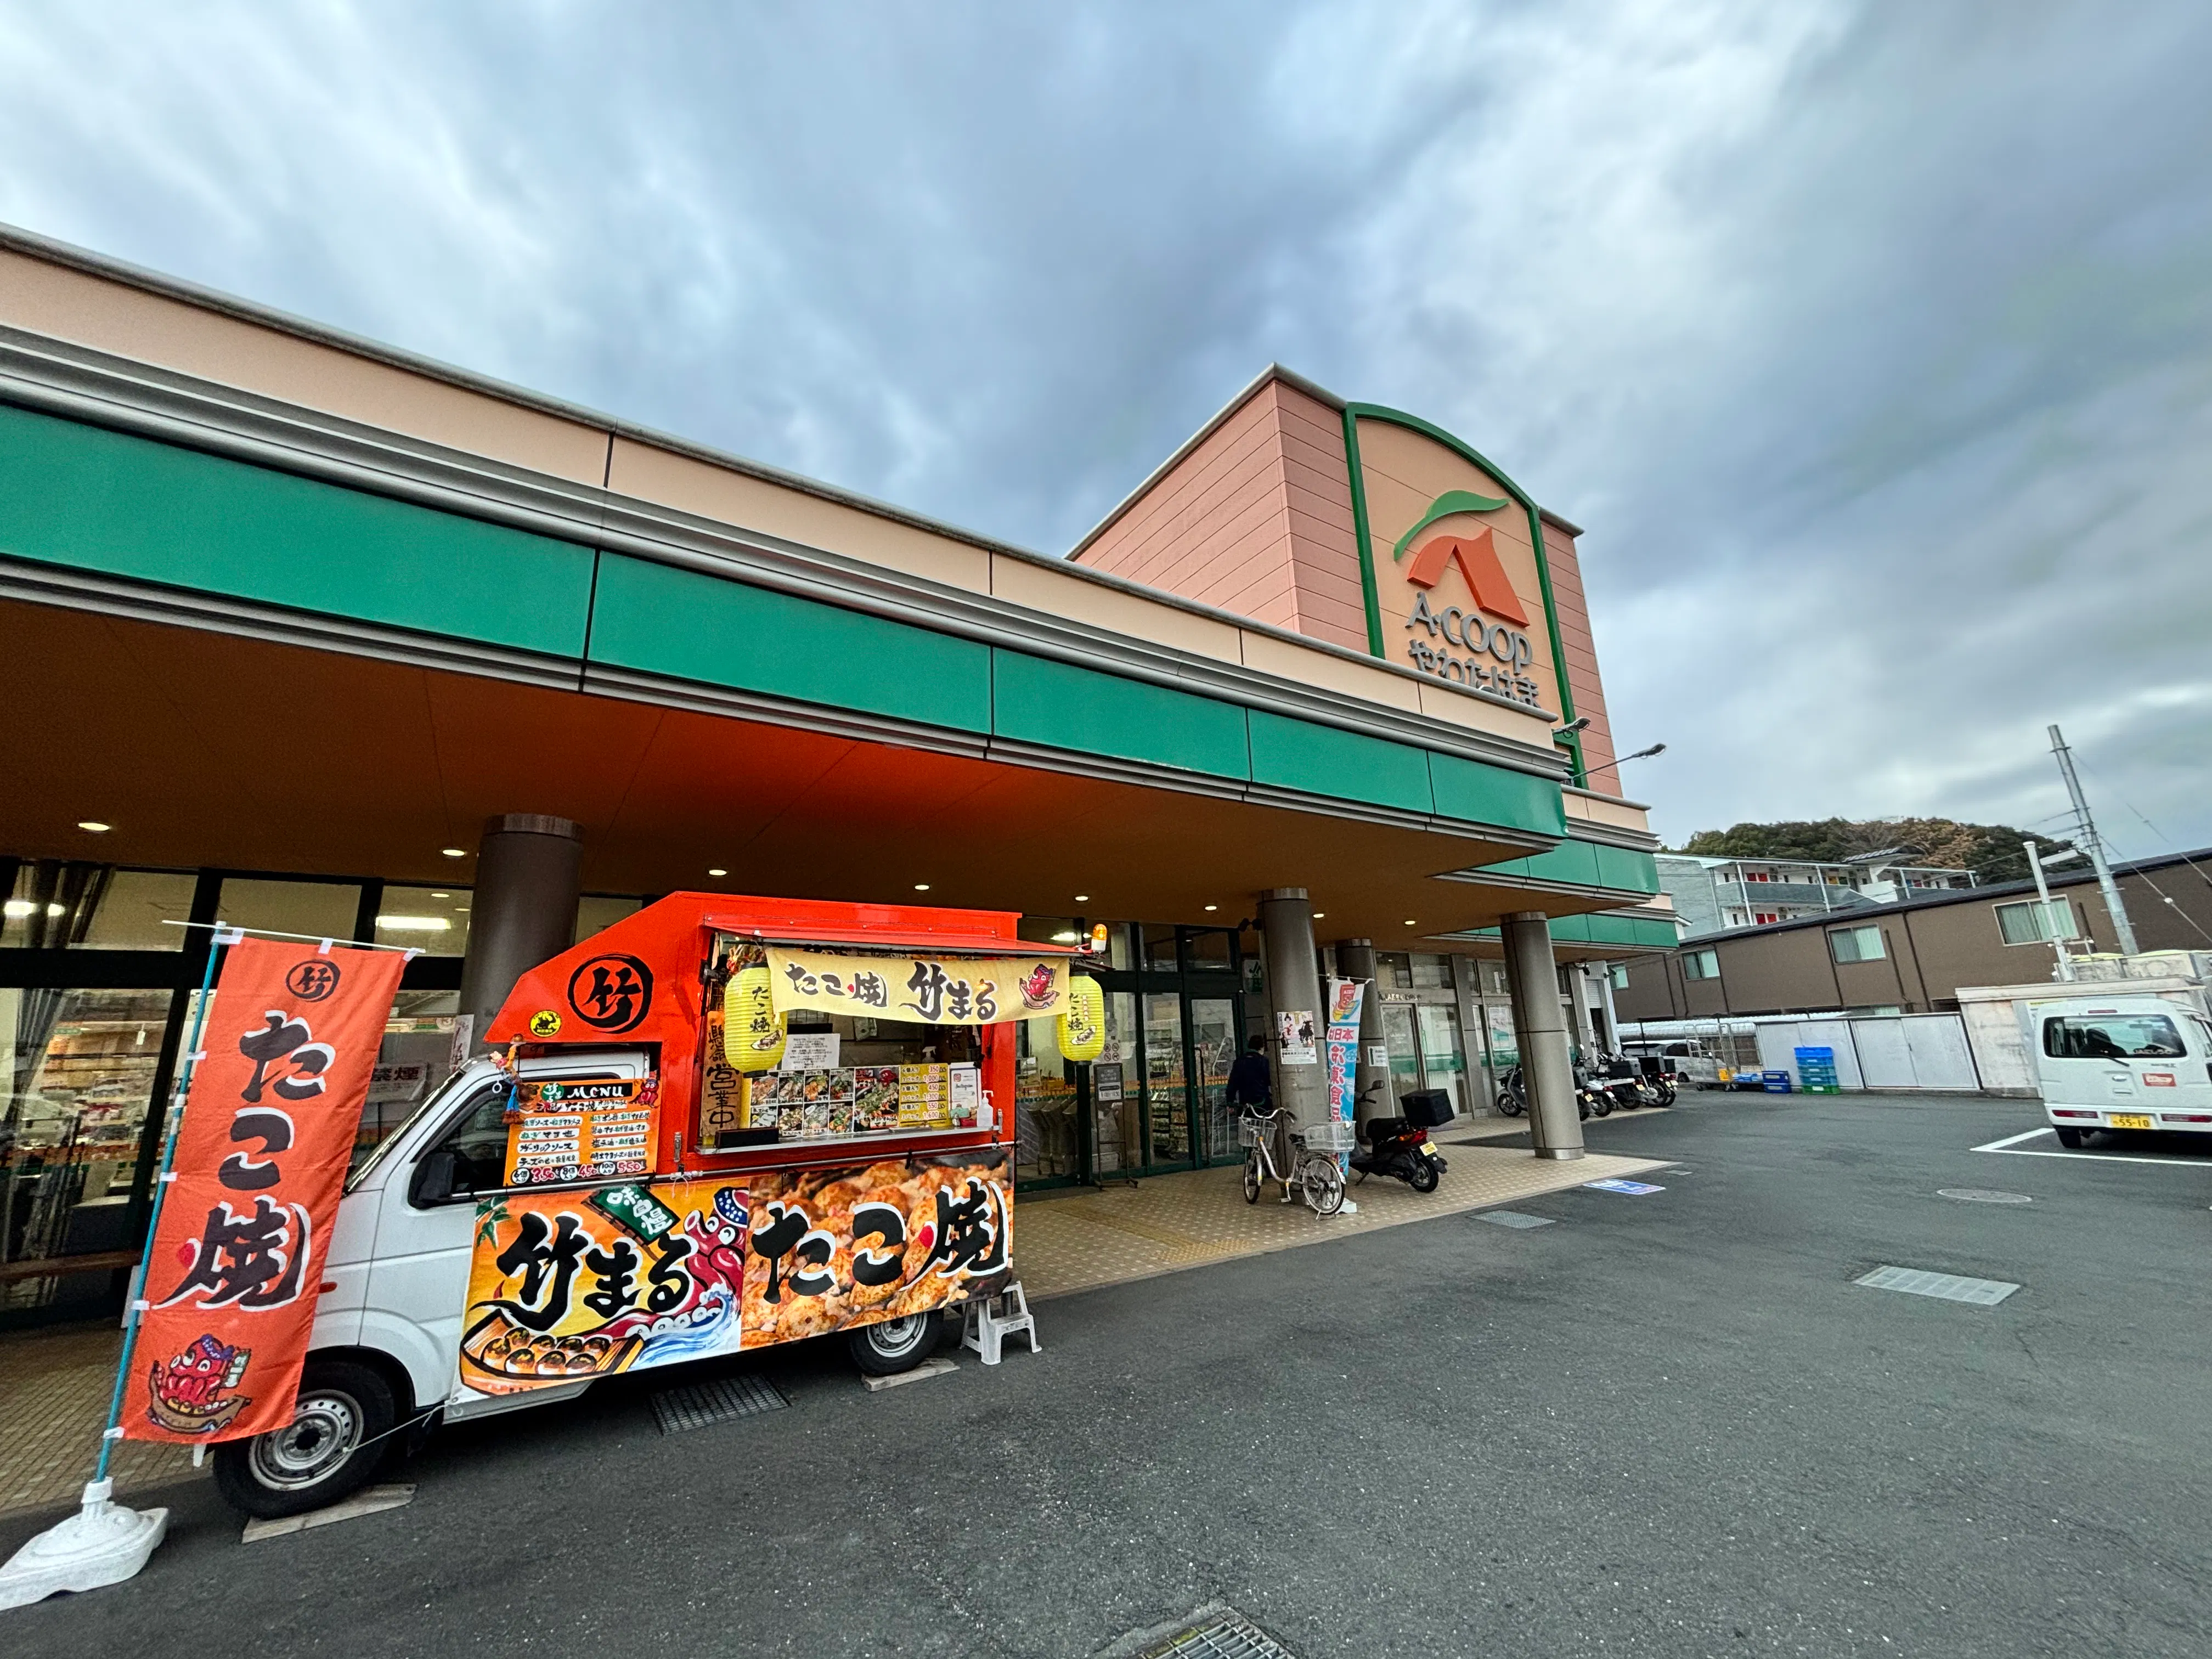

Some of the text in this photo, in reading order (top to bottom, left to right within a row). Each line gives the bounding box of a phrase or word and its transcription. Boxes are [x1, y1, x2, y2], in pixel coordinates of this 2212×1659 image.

[1408, 639, 1542, 709] やわたはま
[750, 986, 771, 1033] たこ焼
[784, 961, 996, 1022] たこ焼 竹まる
[706, 1063, 740, 1128] 営業中
[151, 1010, 336, 1311] たこ焼
[607, 1186, 673, 1235] 味自慢
[752, 1176, 1008, 1305] たこ焼
[472, 1211, 698, 1331] 竹まる
